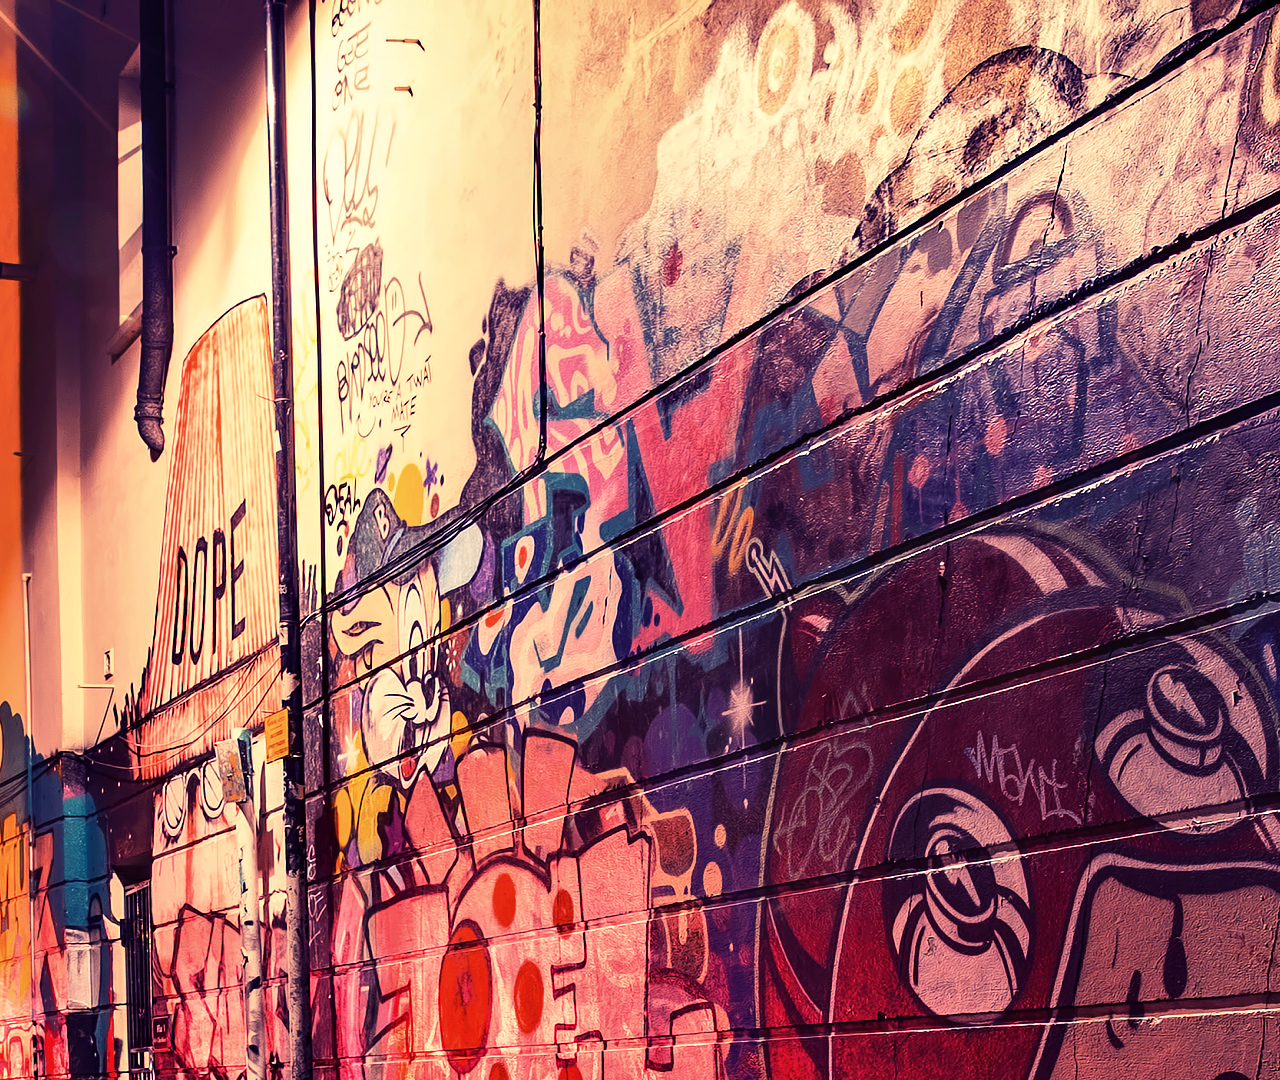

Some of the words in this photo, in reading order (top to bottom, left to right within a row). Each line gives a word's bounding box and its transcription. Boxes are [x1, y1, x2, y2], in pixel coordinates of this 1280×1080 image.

[406, 355, 432, 394] TWAT
[391, 395, 418, 424] MATE
[172, 499, 246, 665] DOPE
